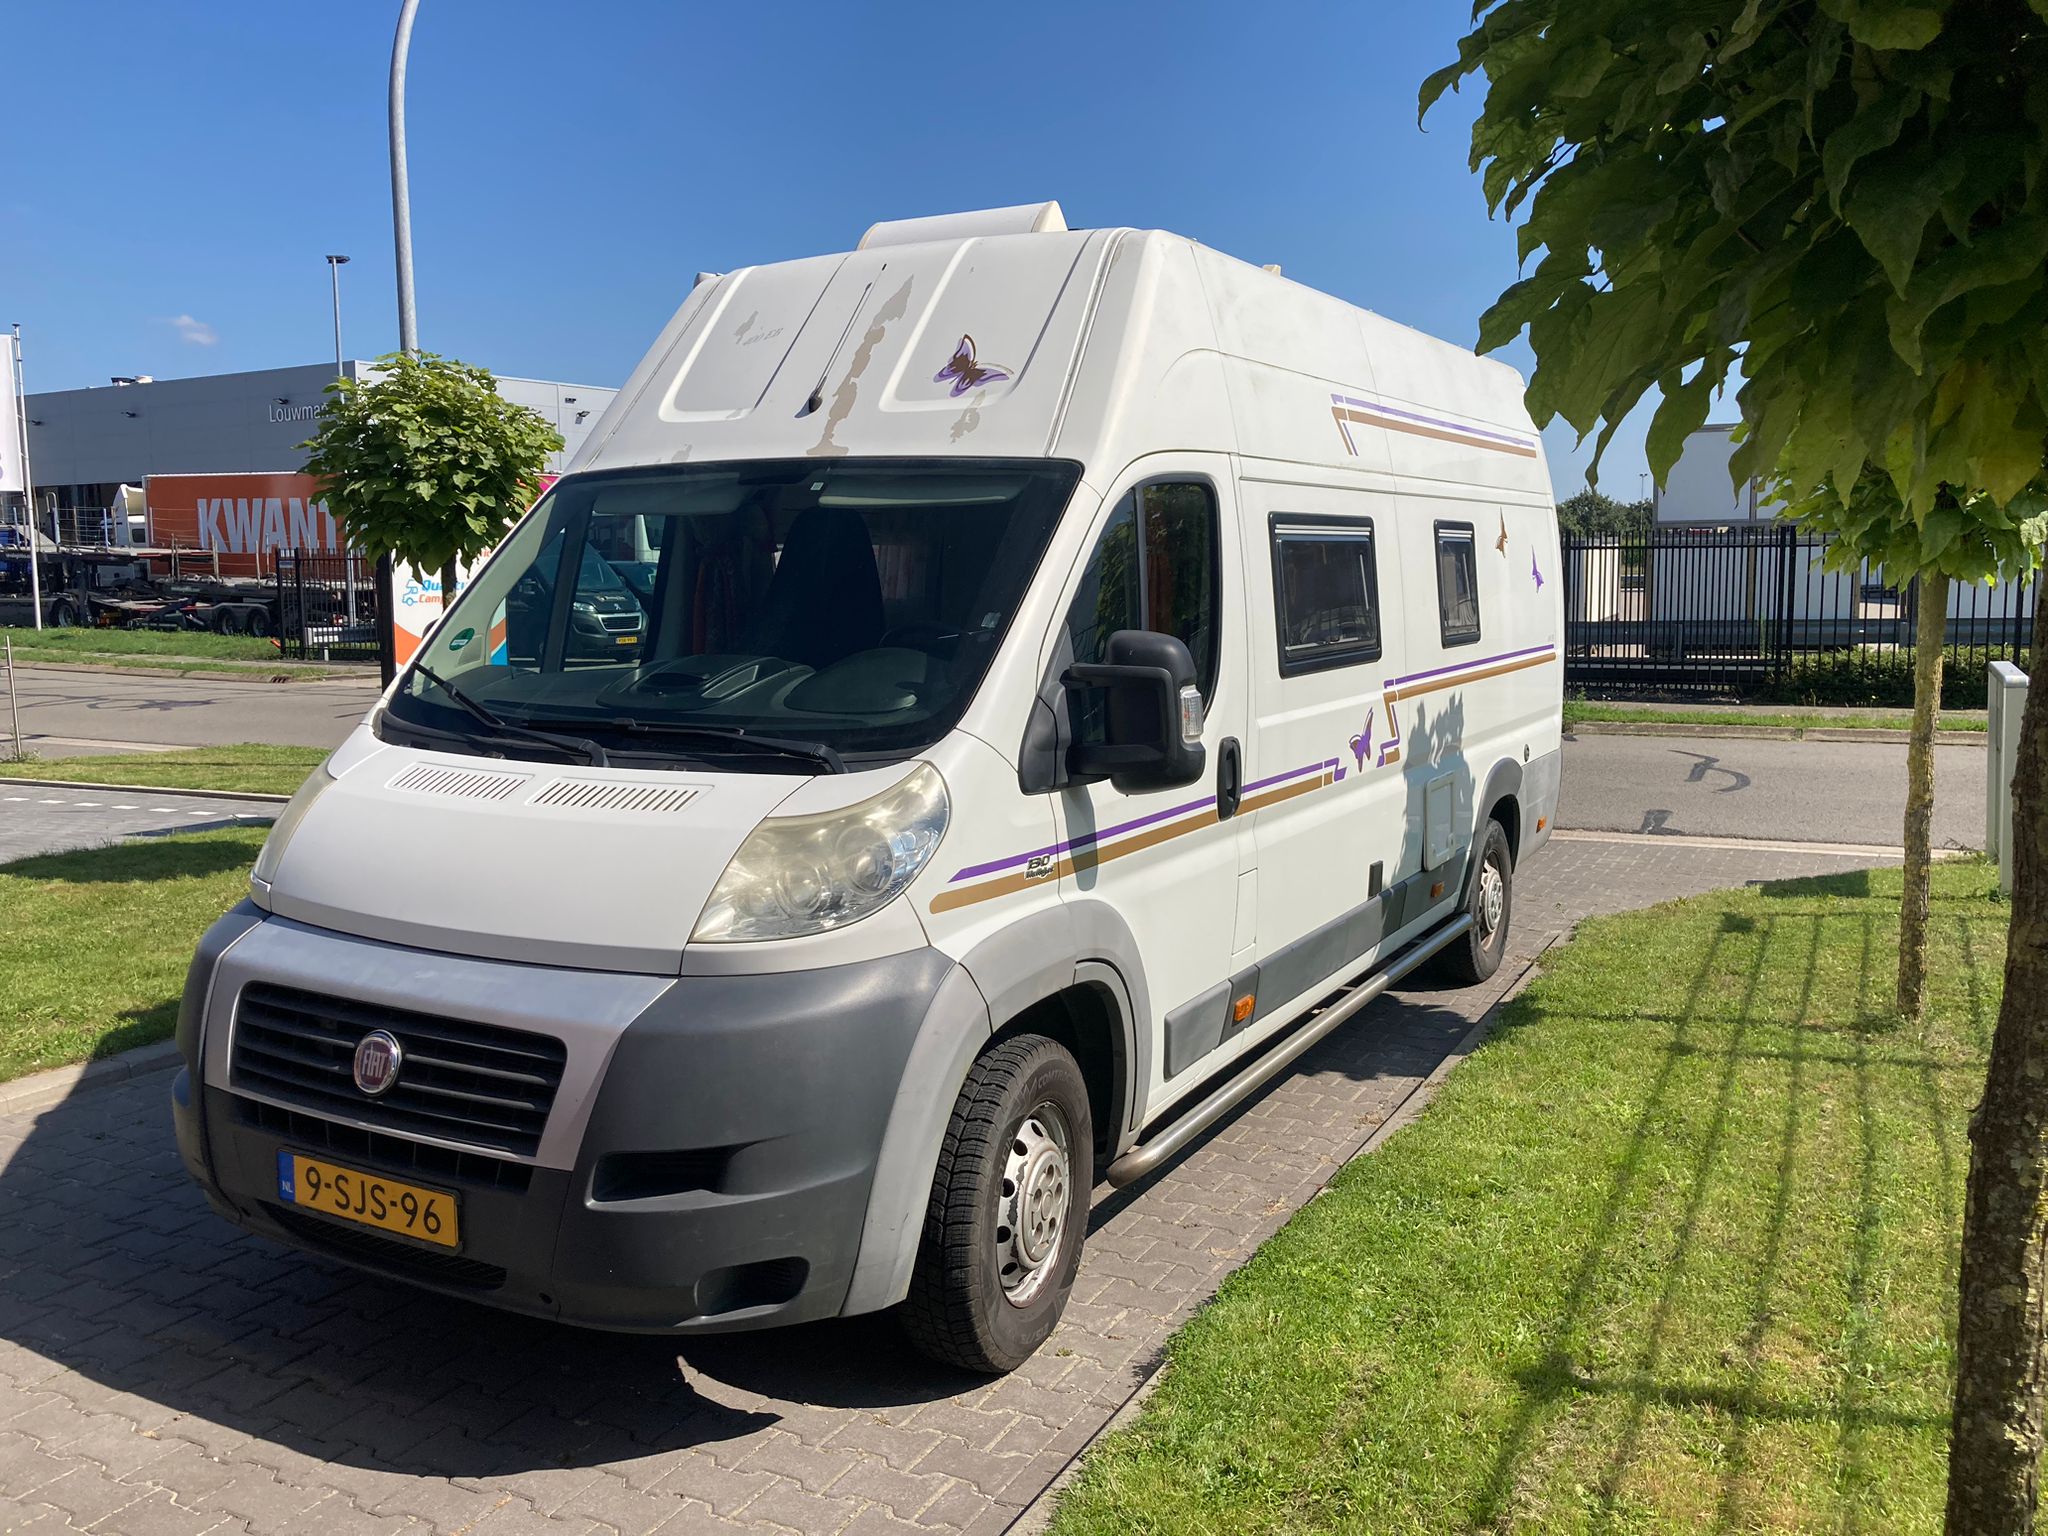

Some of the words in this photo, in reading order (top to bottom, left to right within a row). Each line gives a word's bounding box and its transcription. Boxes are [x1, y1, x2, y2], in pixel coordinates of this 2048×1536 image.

[197, 498, 366, 554] KWANT
[362, 1043, 388, 1078] FIAT
[282, 1181, 293, 1193] NL
[305, 1166, 442, 1235] 9-SJS-96
